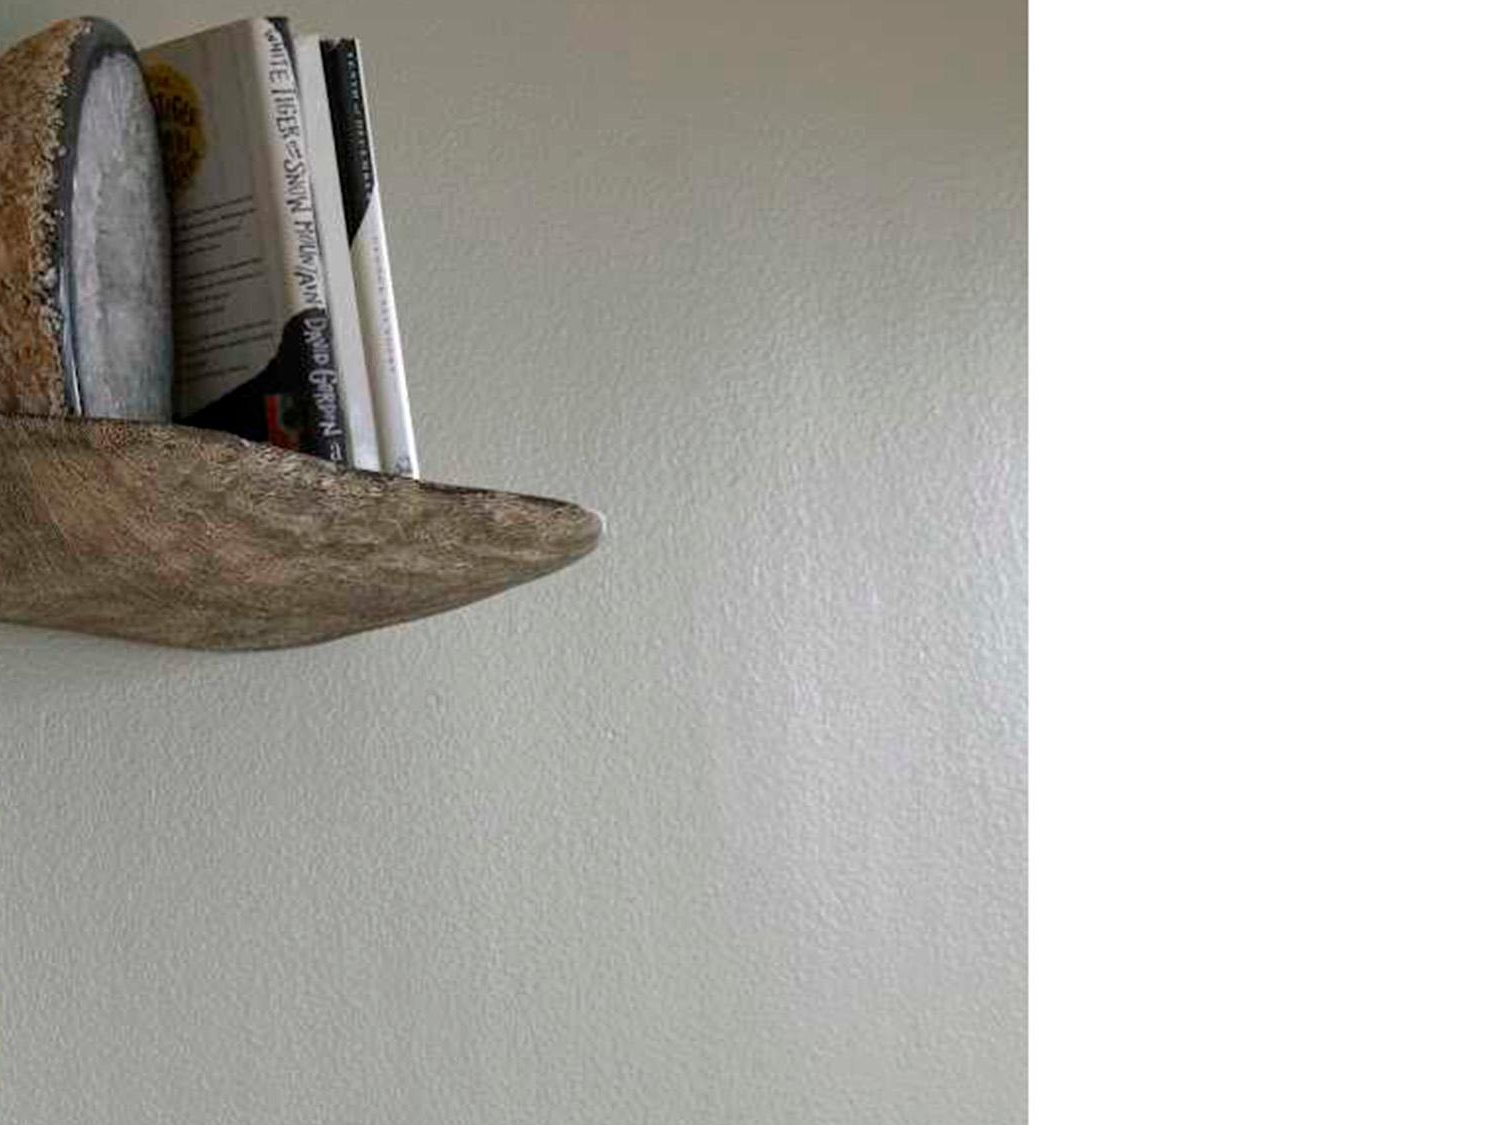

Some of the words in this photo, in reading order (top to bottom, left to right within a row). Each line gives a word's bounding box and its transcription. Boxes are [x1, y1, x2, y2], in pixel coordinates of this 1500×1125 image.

[271, 87, 301, 140] TIGER
[283, 157, 313, 214] SNOW
[304, 316, 330, 365] DAVID
[308, 367, 343, 437] GORDON
